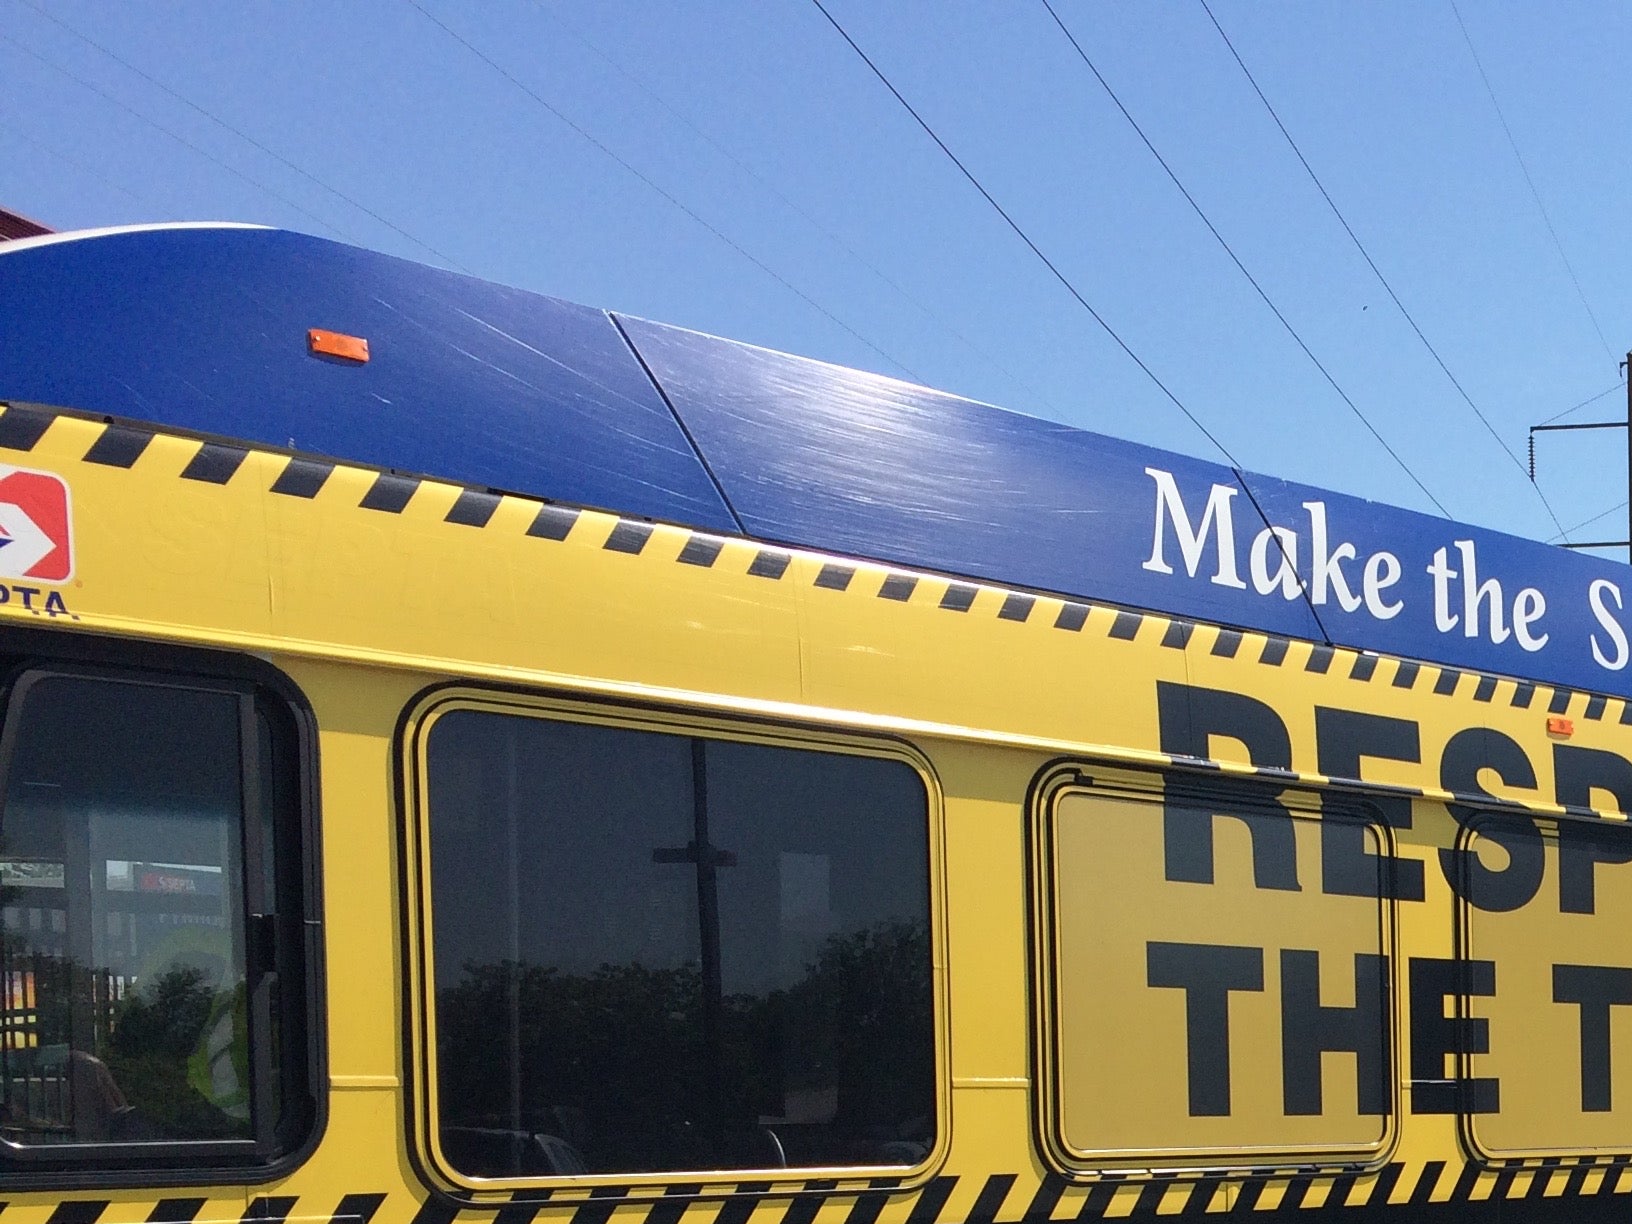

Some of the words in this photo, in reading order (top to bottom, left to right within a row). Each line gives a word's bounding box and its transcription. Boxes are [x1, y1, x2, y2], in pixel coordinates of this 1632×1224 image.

[1143, 466, 1404, 620] Make
[1426, 539, 1549, 652] the
[1146, 941, 1500, 1117] THE
